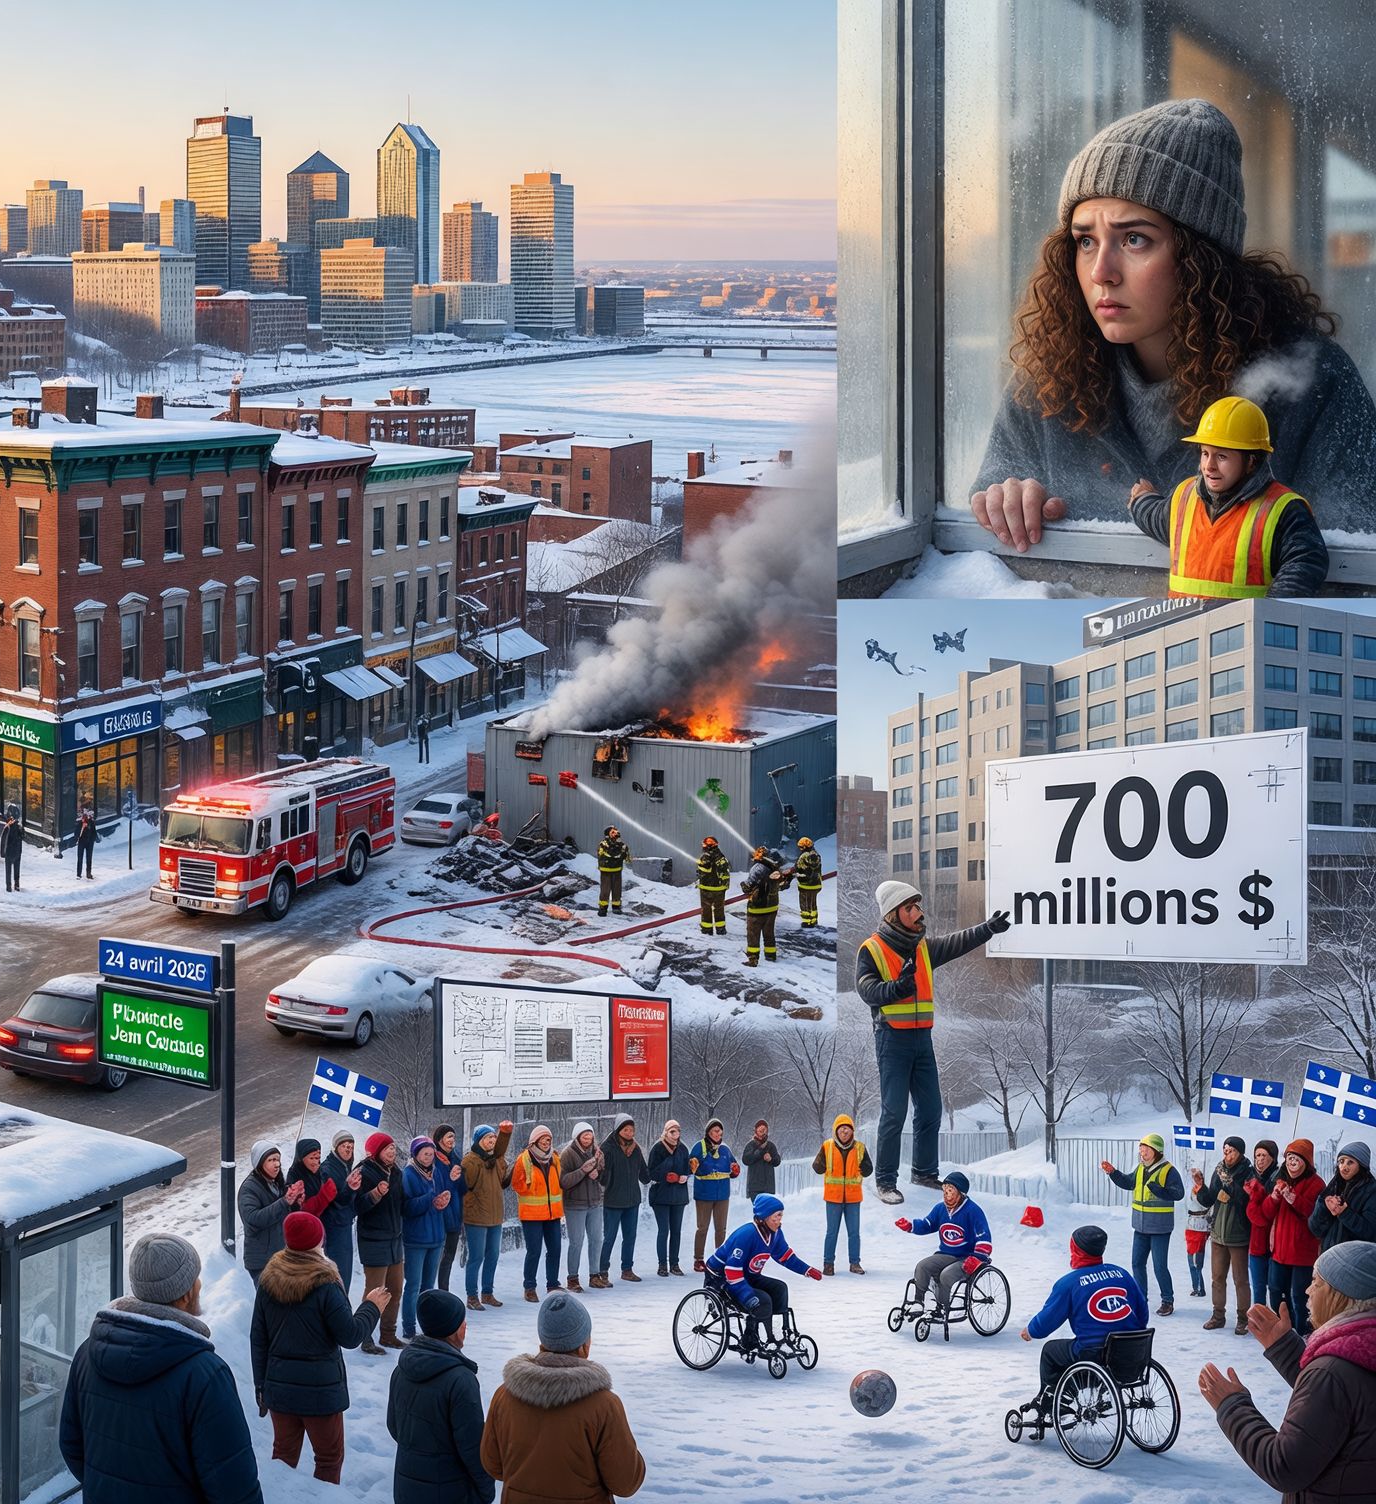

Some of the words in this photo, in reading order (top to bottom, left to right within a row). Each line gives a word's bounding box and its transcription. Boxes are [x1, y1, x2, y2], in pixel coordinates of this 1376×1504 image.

[1044, 770, 1229, 864] 700
[1014, 877, 1219, 926] millions
[1237, 869, 1275, 931] $
[105, 949, 124, 968] 24
[129, 956, 163, 974] avril
